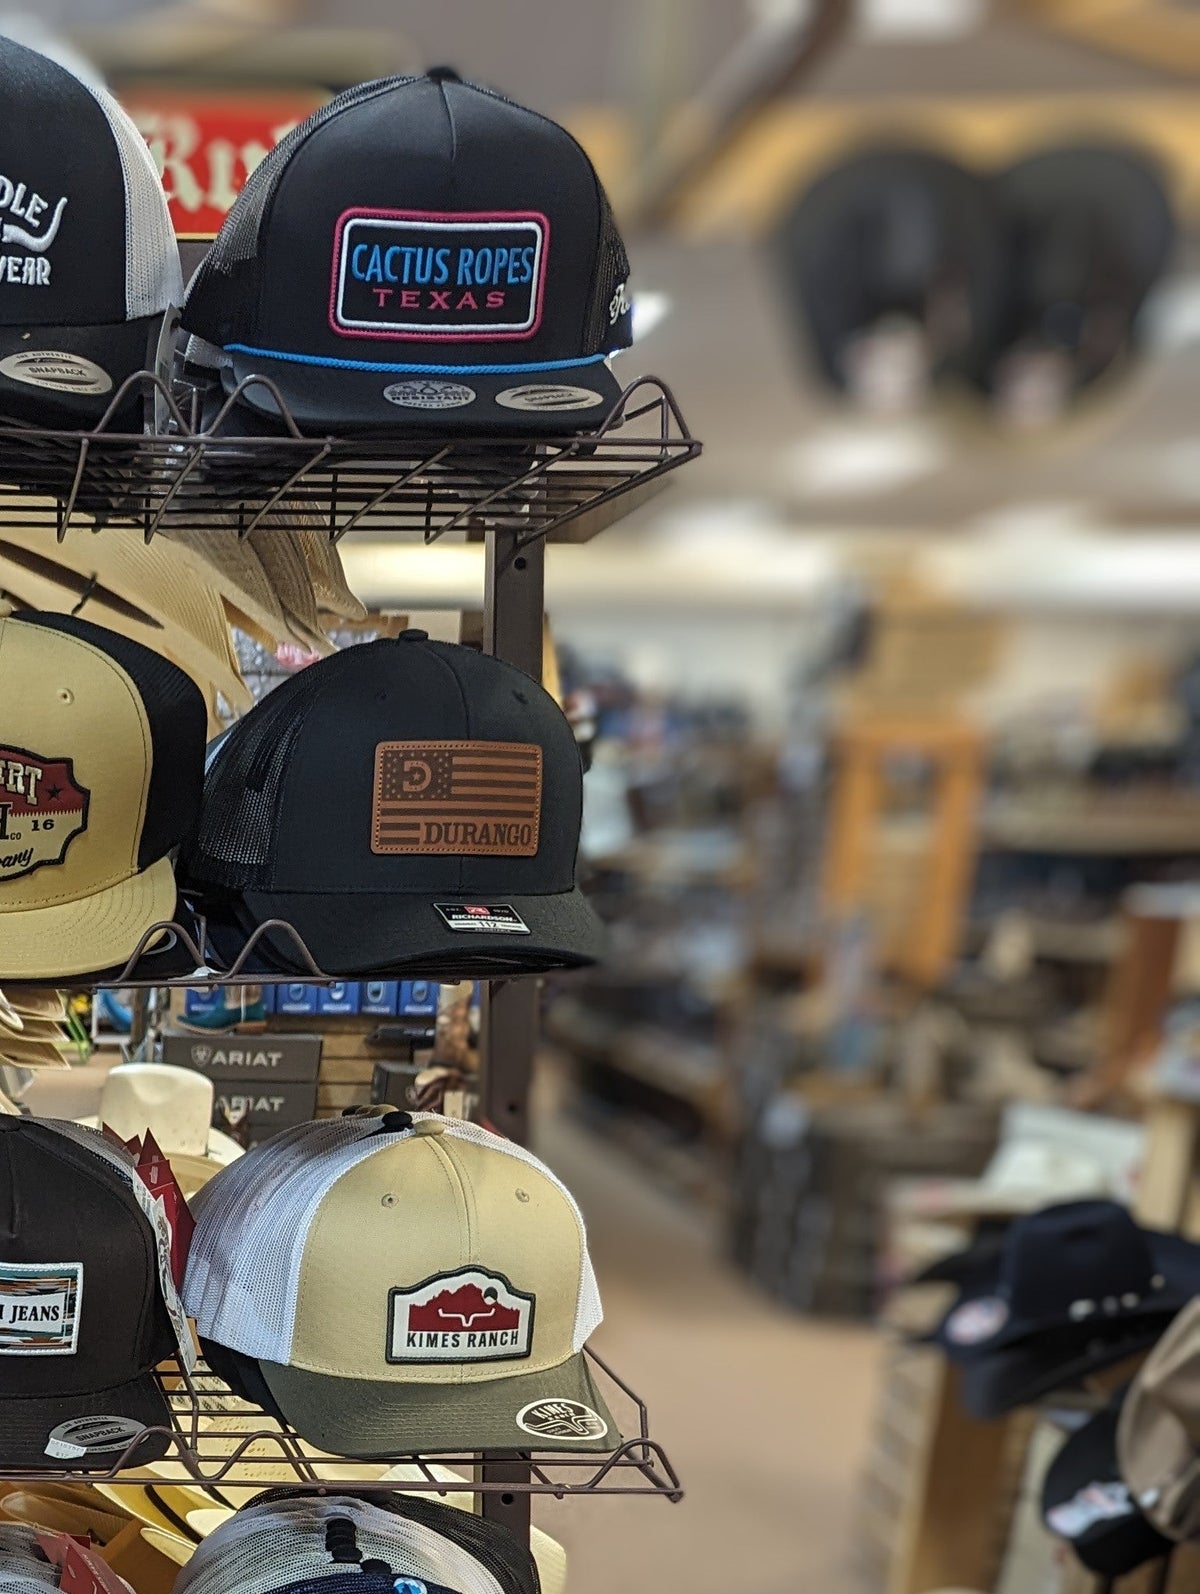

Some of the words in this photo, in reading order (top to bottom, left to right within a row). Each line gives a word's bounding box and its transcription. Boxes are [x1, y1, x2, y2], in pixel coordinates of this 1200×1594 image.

[352, 243, 450, 285] CACTUS
[456, 247, 534, 286] ROPES
[372, 288, 506, 311] TEXAS
[28, 366, 87, 377] SNAPBACK
[31, 819, 55, 832] 16
[423, 822, 532, 846] DURANGO
[452, 914, 513, 922] RICHARDSON
[211, 1052, 283, 1067] ARIAT
[9, 1305, 60, 1323] JEANS
[406, 1333, 461, 1348] KIMES
[467, 1331, 519, 1348] RANCH
[531, 1403, 574, 1419] KIMES
[76, 1426, 126, 1441] SNAPBACK
